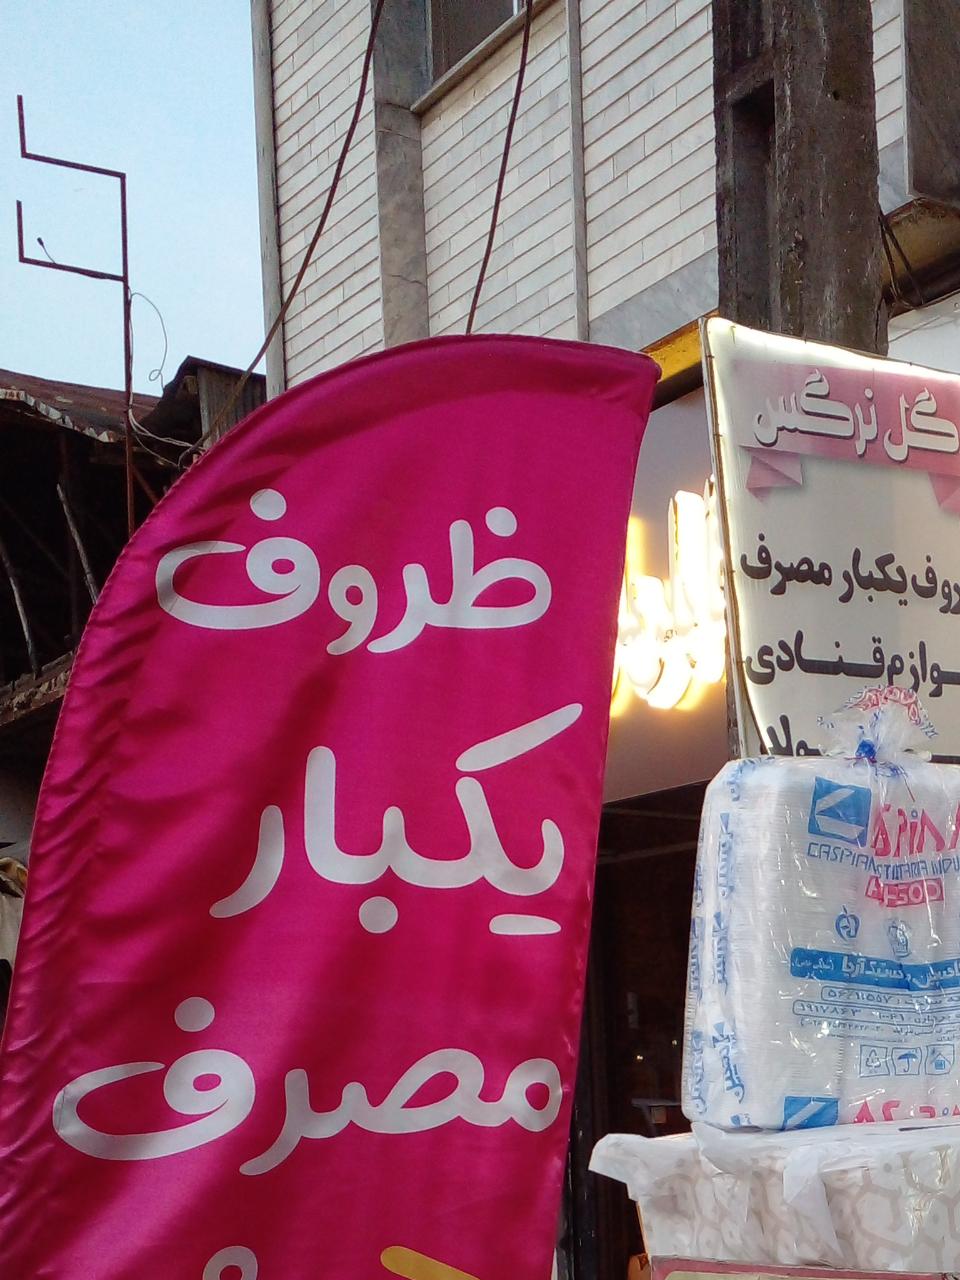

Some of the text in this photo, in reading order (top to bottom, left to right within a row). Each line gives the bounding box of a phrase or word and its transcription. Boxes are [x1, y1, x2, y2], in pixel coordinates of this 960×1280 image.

[752, 368, 959, 462] گل نرگس
[156, 488, 552, 655] ظروف
[739, 533, 834, 596] مصرف
[838, 547, 908, 607] یکبار
[744, 629, 885, 686] قنادی
[209, 703, 584, 936] یکبار
[52, 997, 562, 1177] مصرف
